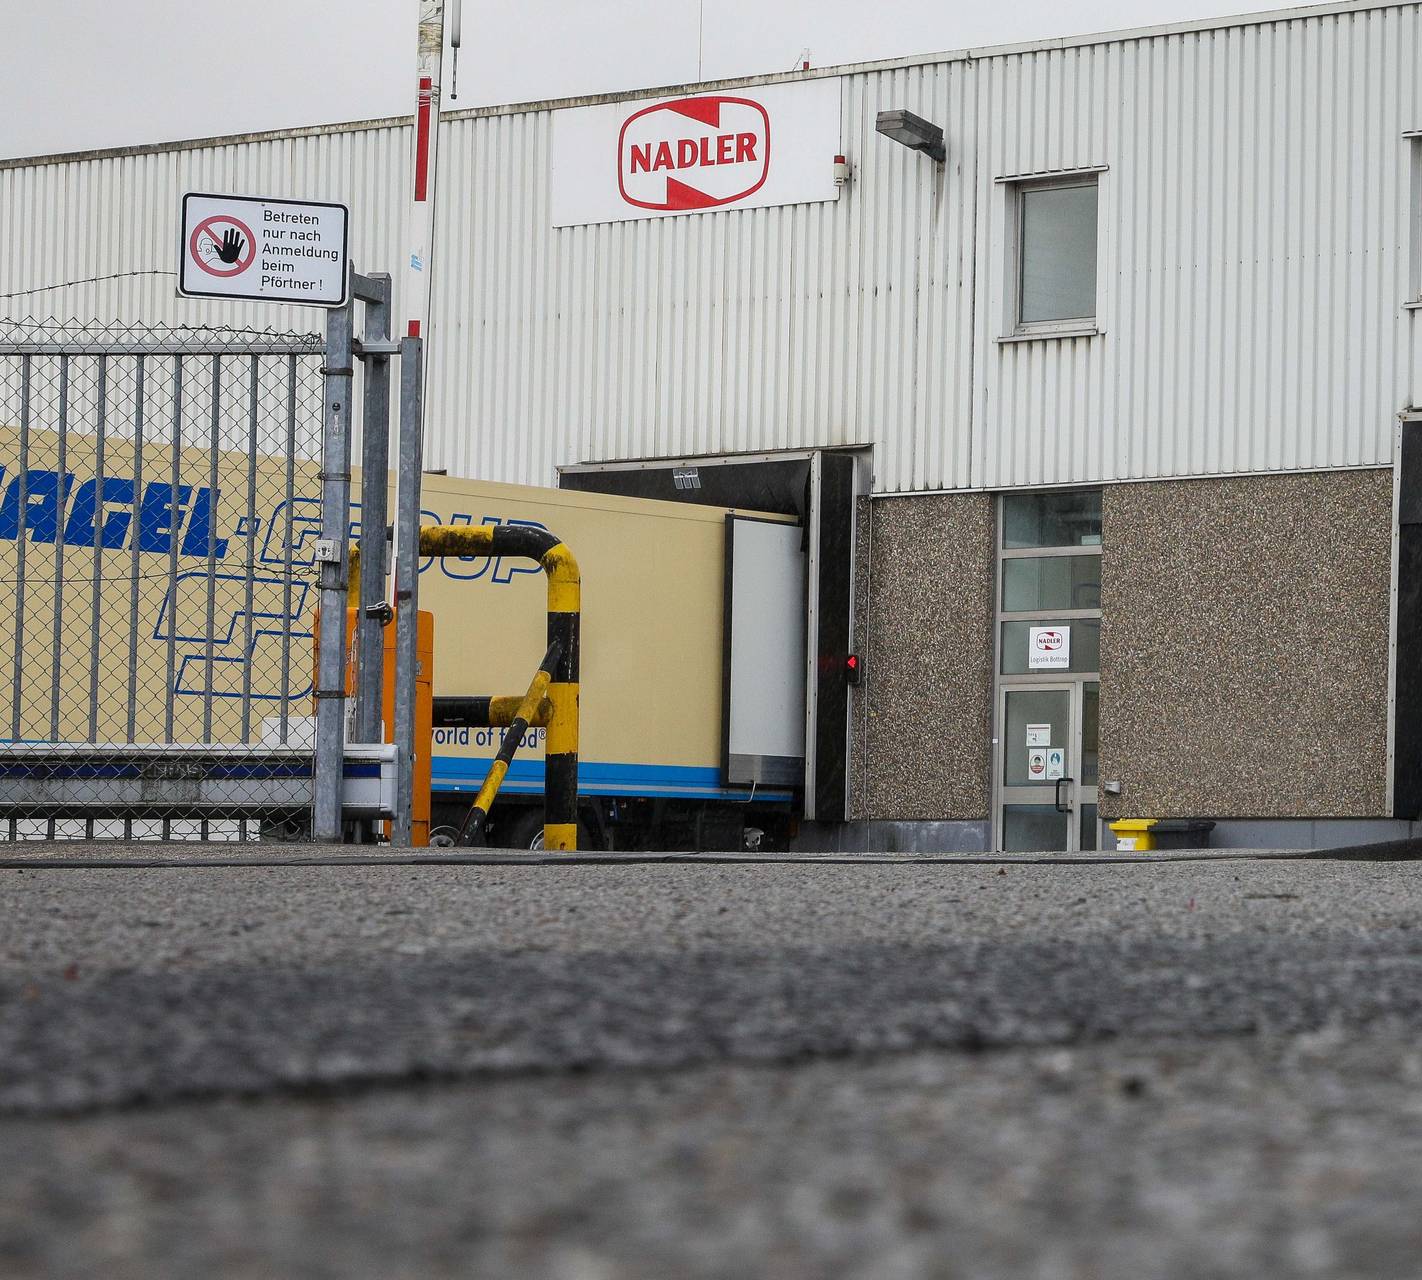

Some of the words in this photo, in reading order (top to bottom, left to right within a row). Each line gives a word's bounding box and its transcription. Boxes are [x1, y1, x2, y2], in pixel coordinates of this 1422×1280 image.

[630, 132, 758, 174] NADLER
[263, 210, 319, 225] Betreten
[263, 229, 286, 239] nur
[289, 230, 321, 241] nach
[262, 243, 338, 262] Anmeldung
[262, 259, 294, 272] beim
[261, 275, 316, 290] Pförtner
[319, 279, 323, 290] !
[1030, 656, 1049, 664] Logistik
[432, 727, 469, 746] orld
[476, 727, 493, 746] of
